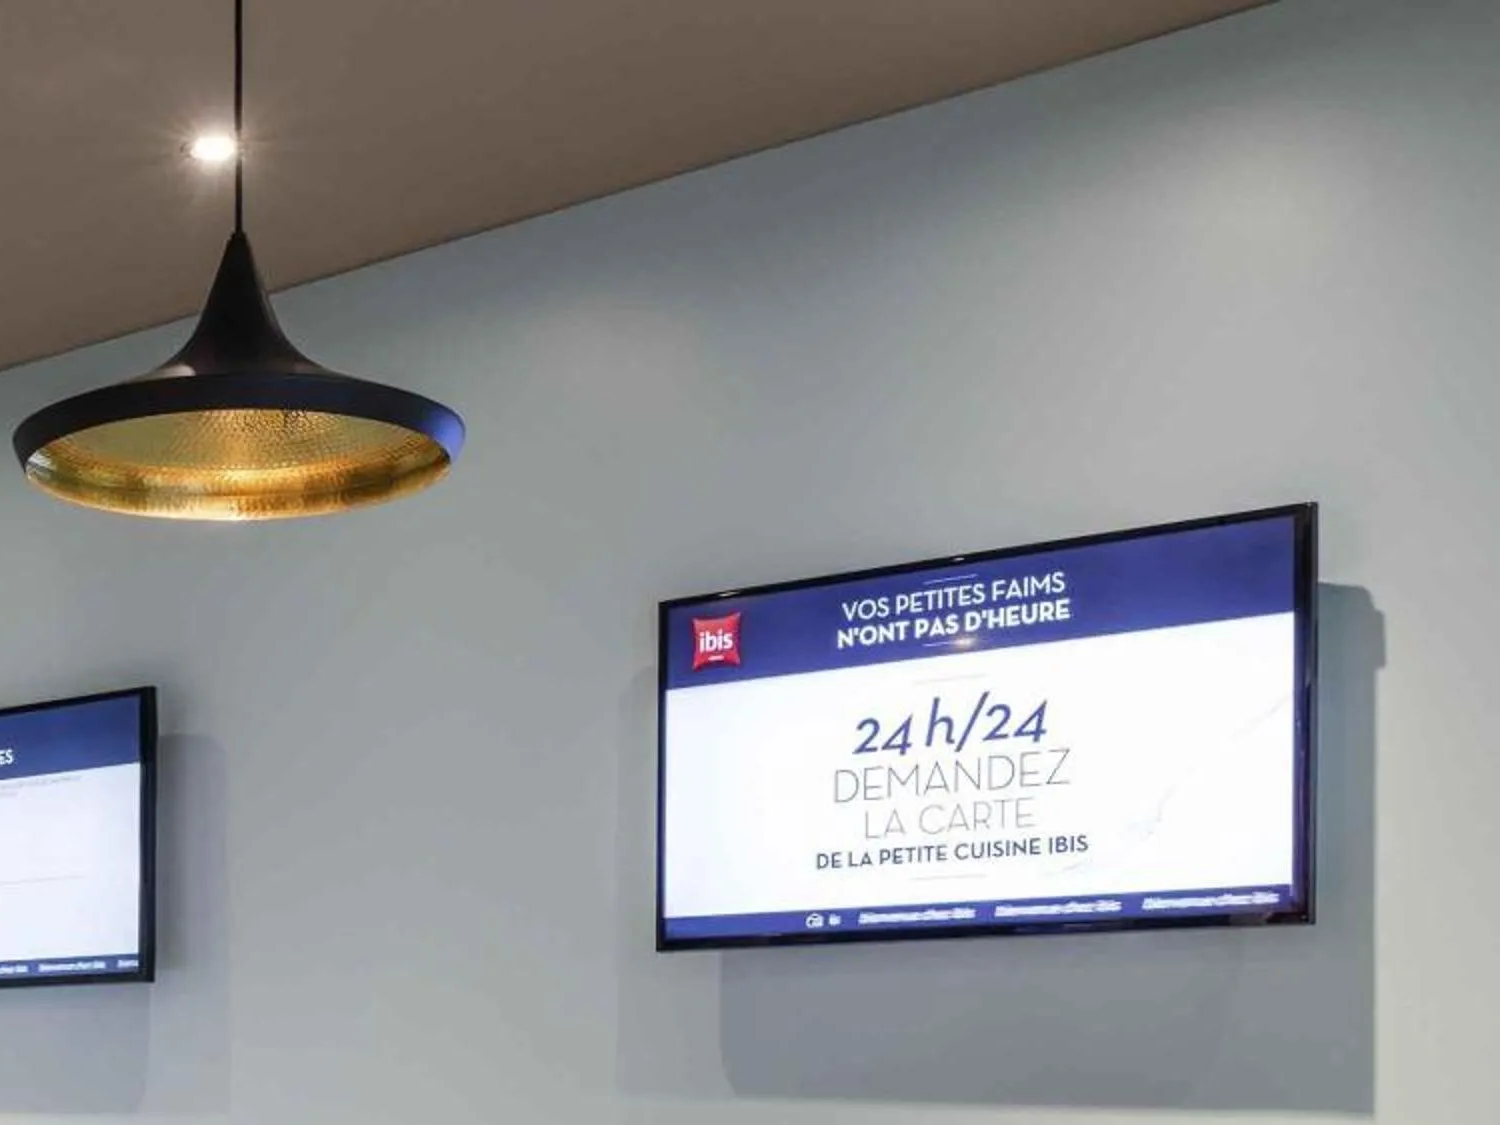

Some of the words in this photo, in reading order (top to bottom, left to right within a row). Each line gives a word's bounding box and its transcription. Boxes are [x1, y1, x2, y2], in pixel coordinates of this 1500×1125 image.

[841, 596, 890, 622] VOS
[895, 583, 985, 616] PETITES
[991, 571, 1065, 604] FAIMS
[699, 628, 733, 653] ibis
[836, 621, 911, 650] N'ONT
[914, 614, 959, 639] PAS
[964, 598, 1071, 633] D'HEURE
[833, 748, 1071, 804] DEMANDEZ
[864, 808, 907, 840] LA
[918, 796, 1036, 835] CARTE
[815, 852, 843, 870] DE
[847, 850, 873, 867] LA
[879, 843, 948, 865] PETITE
[953, 837, 1042, 861] CUISINE
[1049, 834, 1089, 855] IBIS
